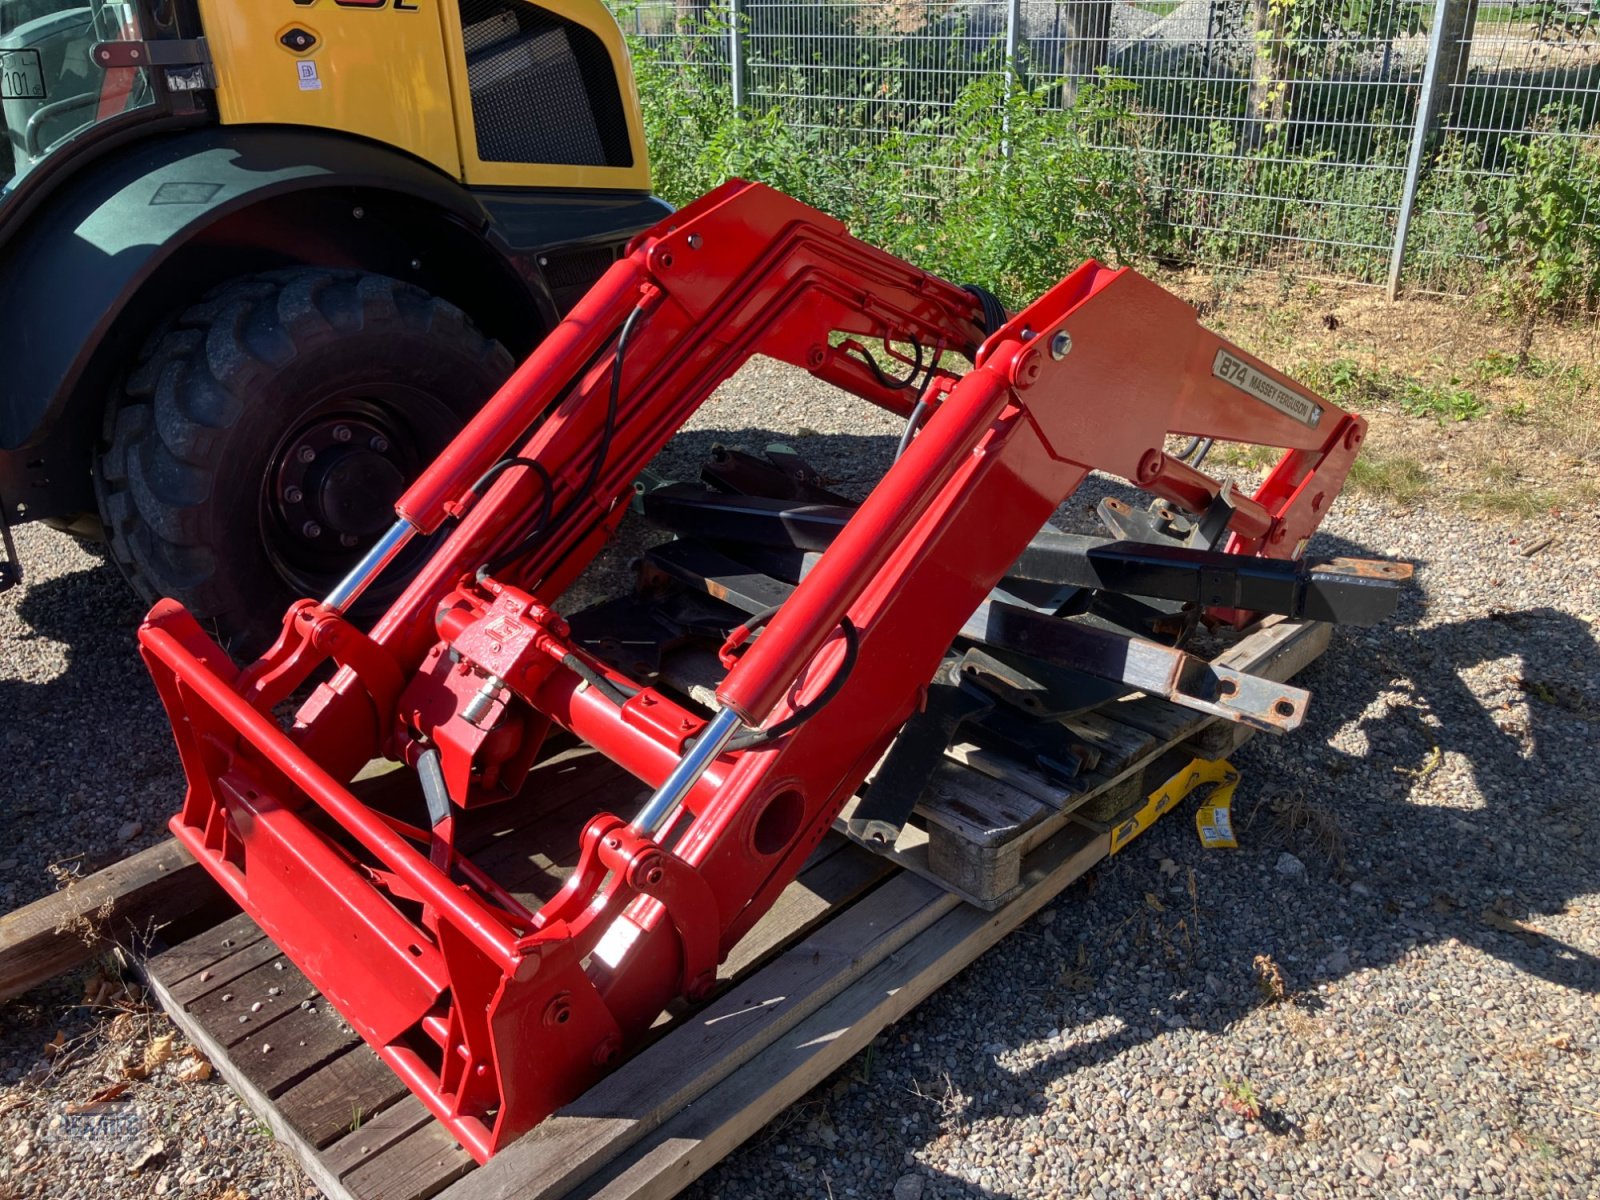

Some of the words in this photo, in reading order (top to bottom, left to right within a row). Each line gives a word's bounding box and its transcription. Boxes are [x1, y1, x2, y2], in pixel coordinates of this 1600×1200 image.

[5, 71, 30, 96] 101
[1219, 357, 1248, 386] 874
[1249, 376, 1278, 399] MASSEY
[1276, 390, 1309, 417] FERGUSON
